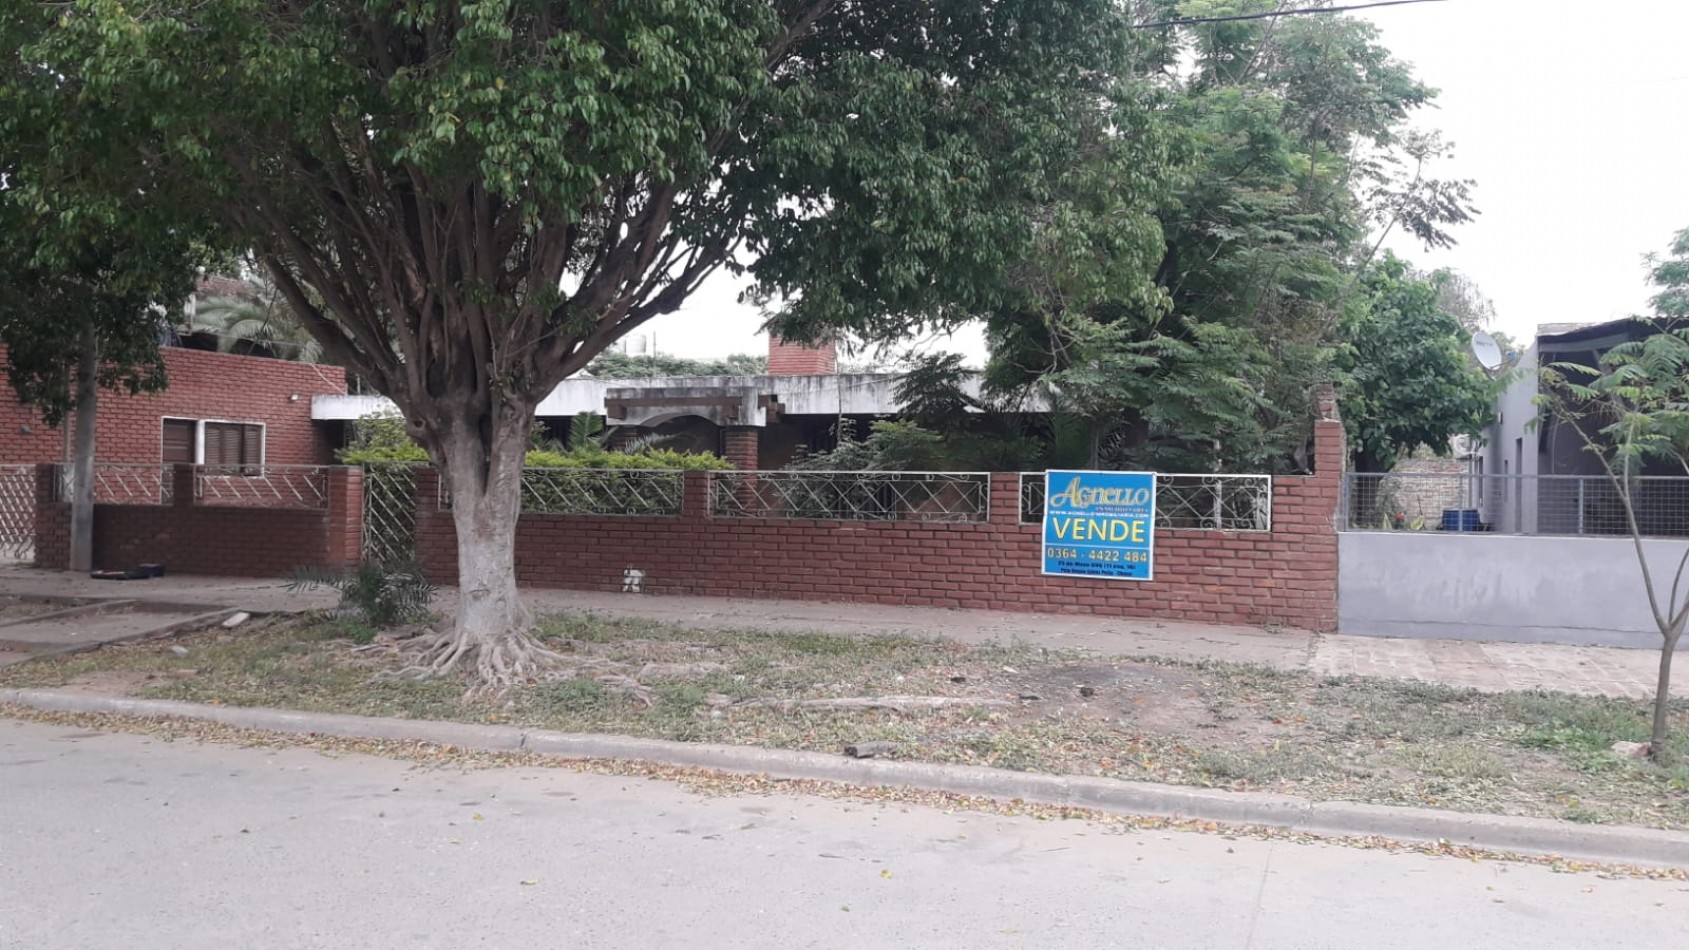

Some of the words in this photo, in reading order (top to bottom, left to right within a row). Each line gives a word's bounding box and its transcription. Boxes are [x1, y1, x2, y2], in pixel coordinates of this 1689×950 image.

[1053, 517, 1145, 542] VENDE
[1047, 547, 1077, 559] 0364
[1088, 550, 1120, 562] 4422
[1124, 551, 1147, 563] 484
